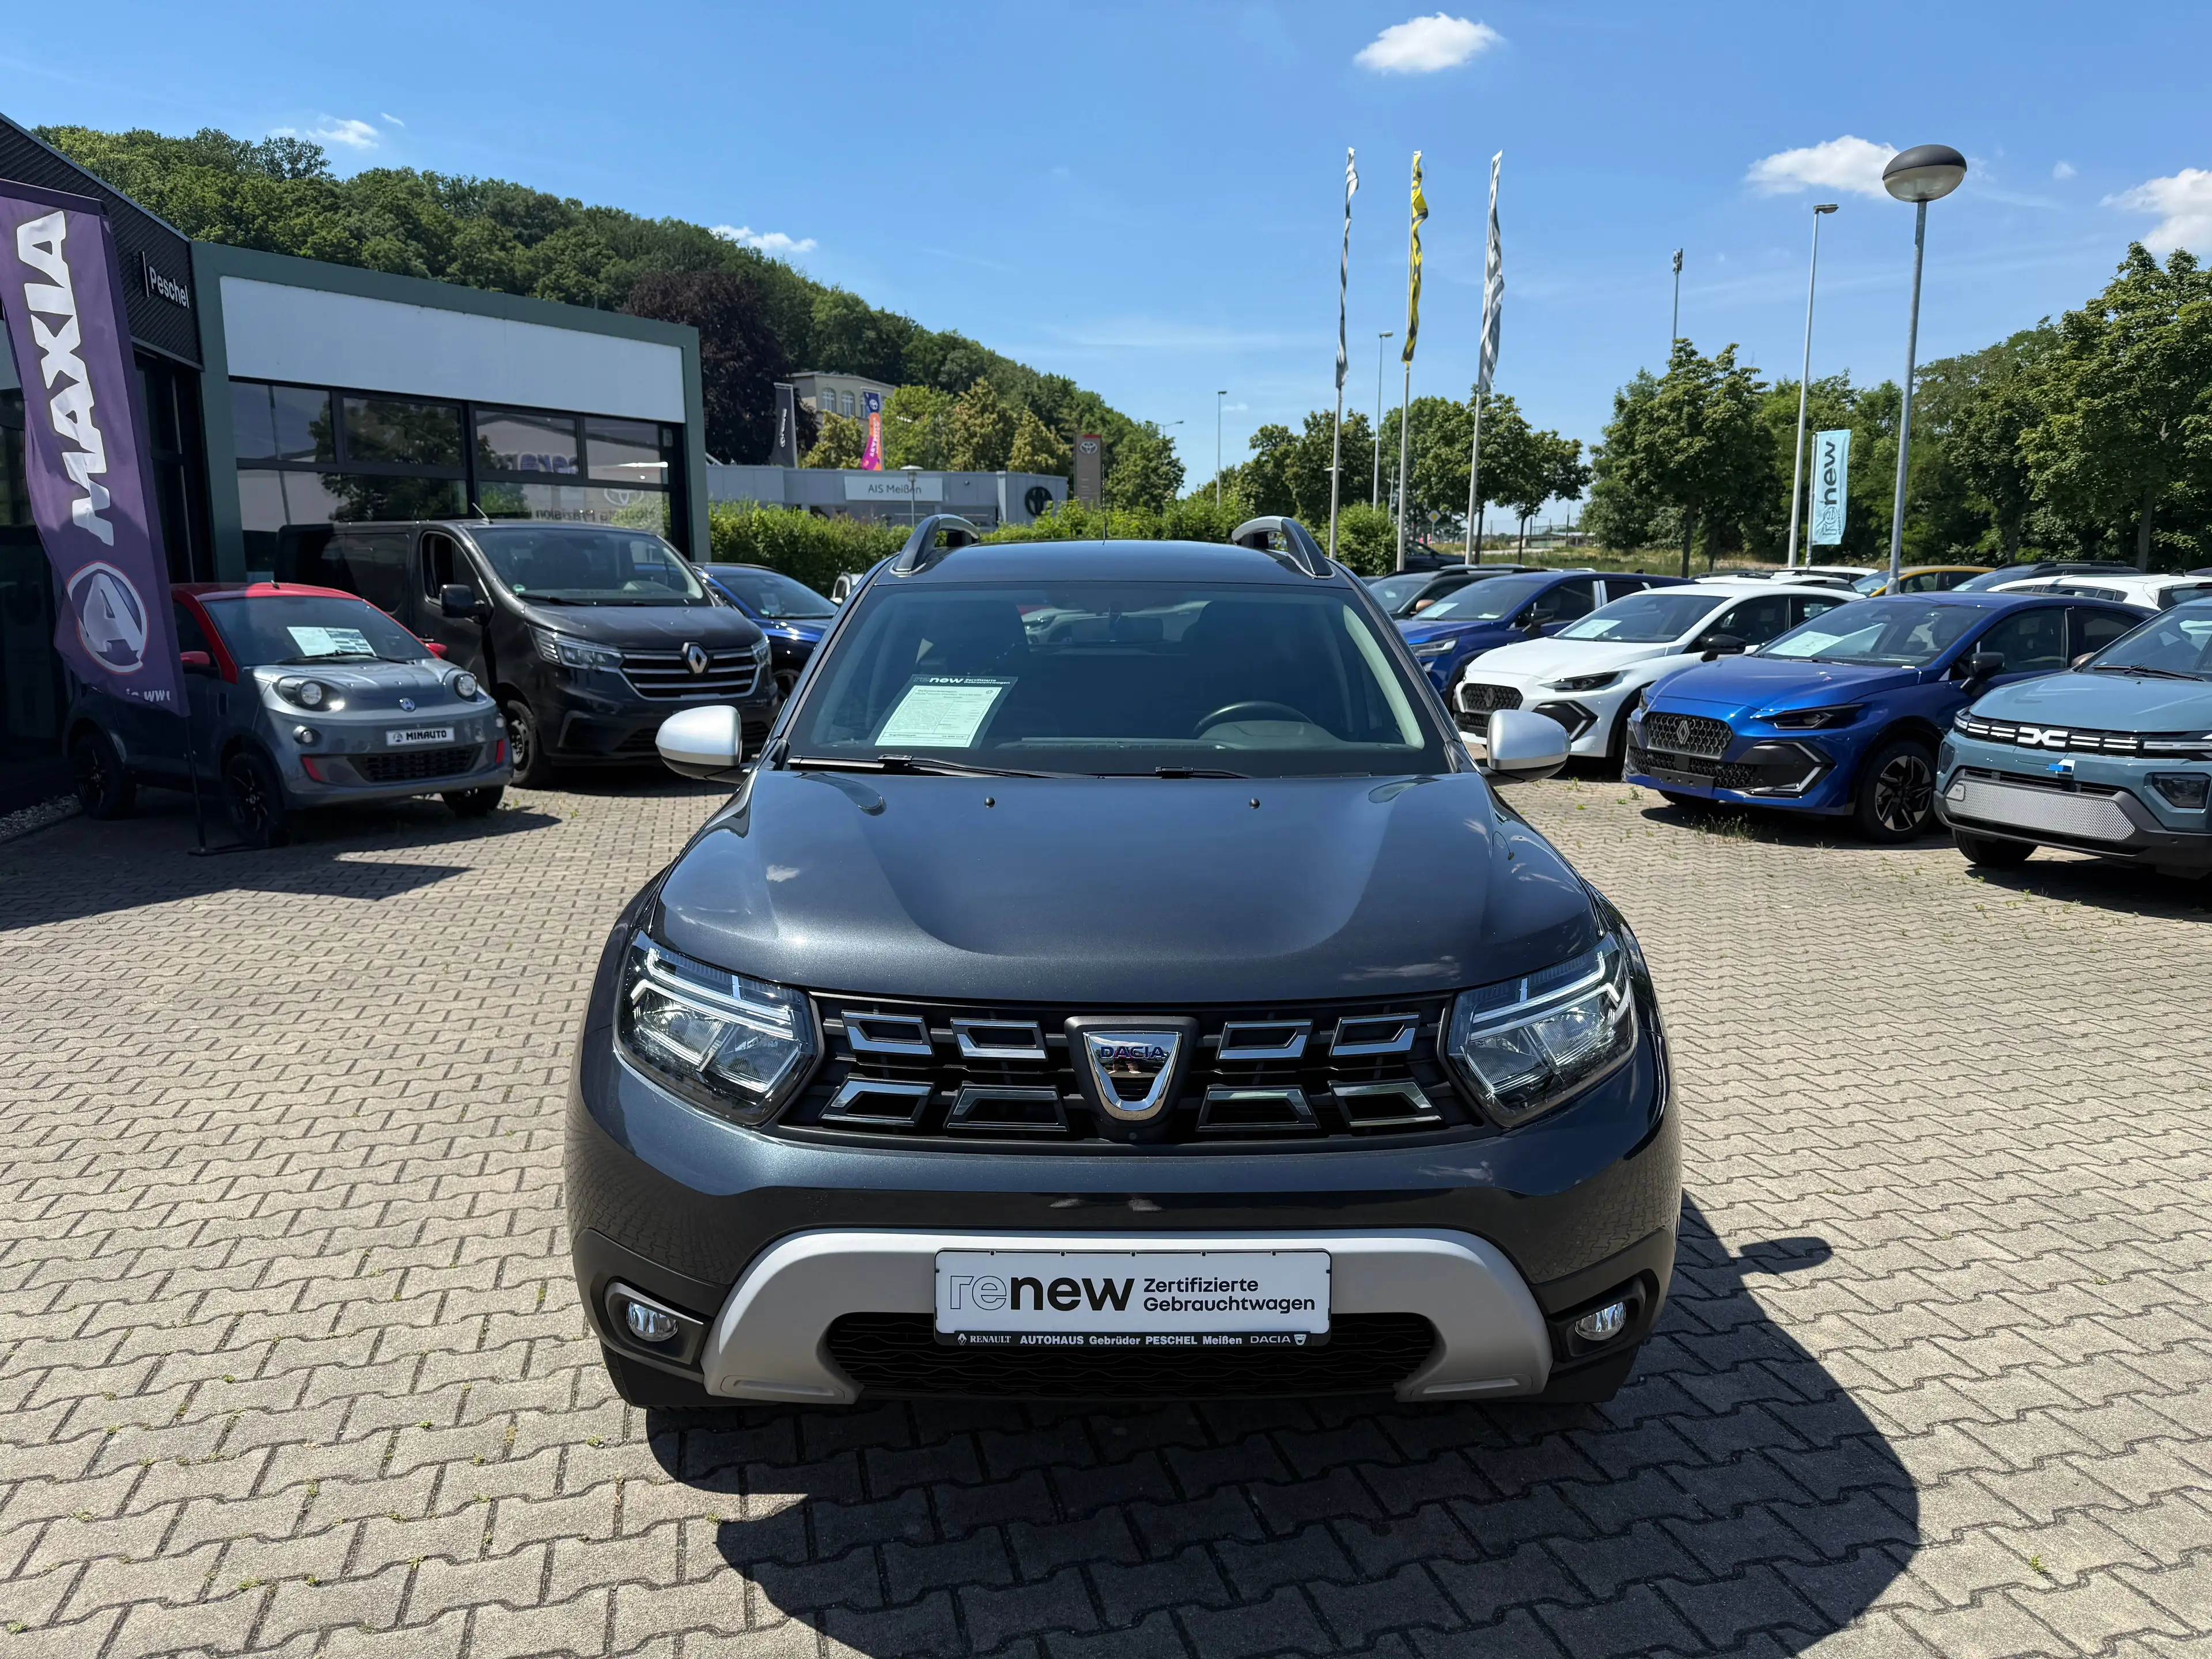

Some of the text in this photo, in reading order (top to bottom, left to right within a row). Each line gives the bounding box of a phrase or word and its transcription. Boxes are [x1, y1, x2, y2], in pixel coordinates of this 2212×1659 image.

[149, 266, 190, 309] Peschel
[868, 484, 884, 494] AIS
[406, 730, 446, 740] MINAUTO
[1101, 1046, 1166, 1059] DACIA
[1143, 1277, 1259, 1293] Zertifizierte
[950, 1275, 1135, 1311] renew
[1143, 1296, 1315, 1314] Gebrauchtwagen
[970, 1335, 1291, 1345] RENAULT AUTOHAUS Gebrüder PESCHEL Meißen DACIA
